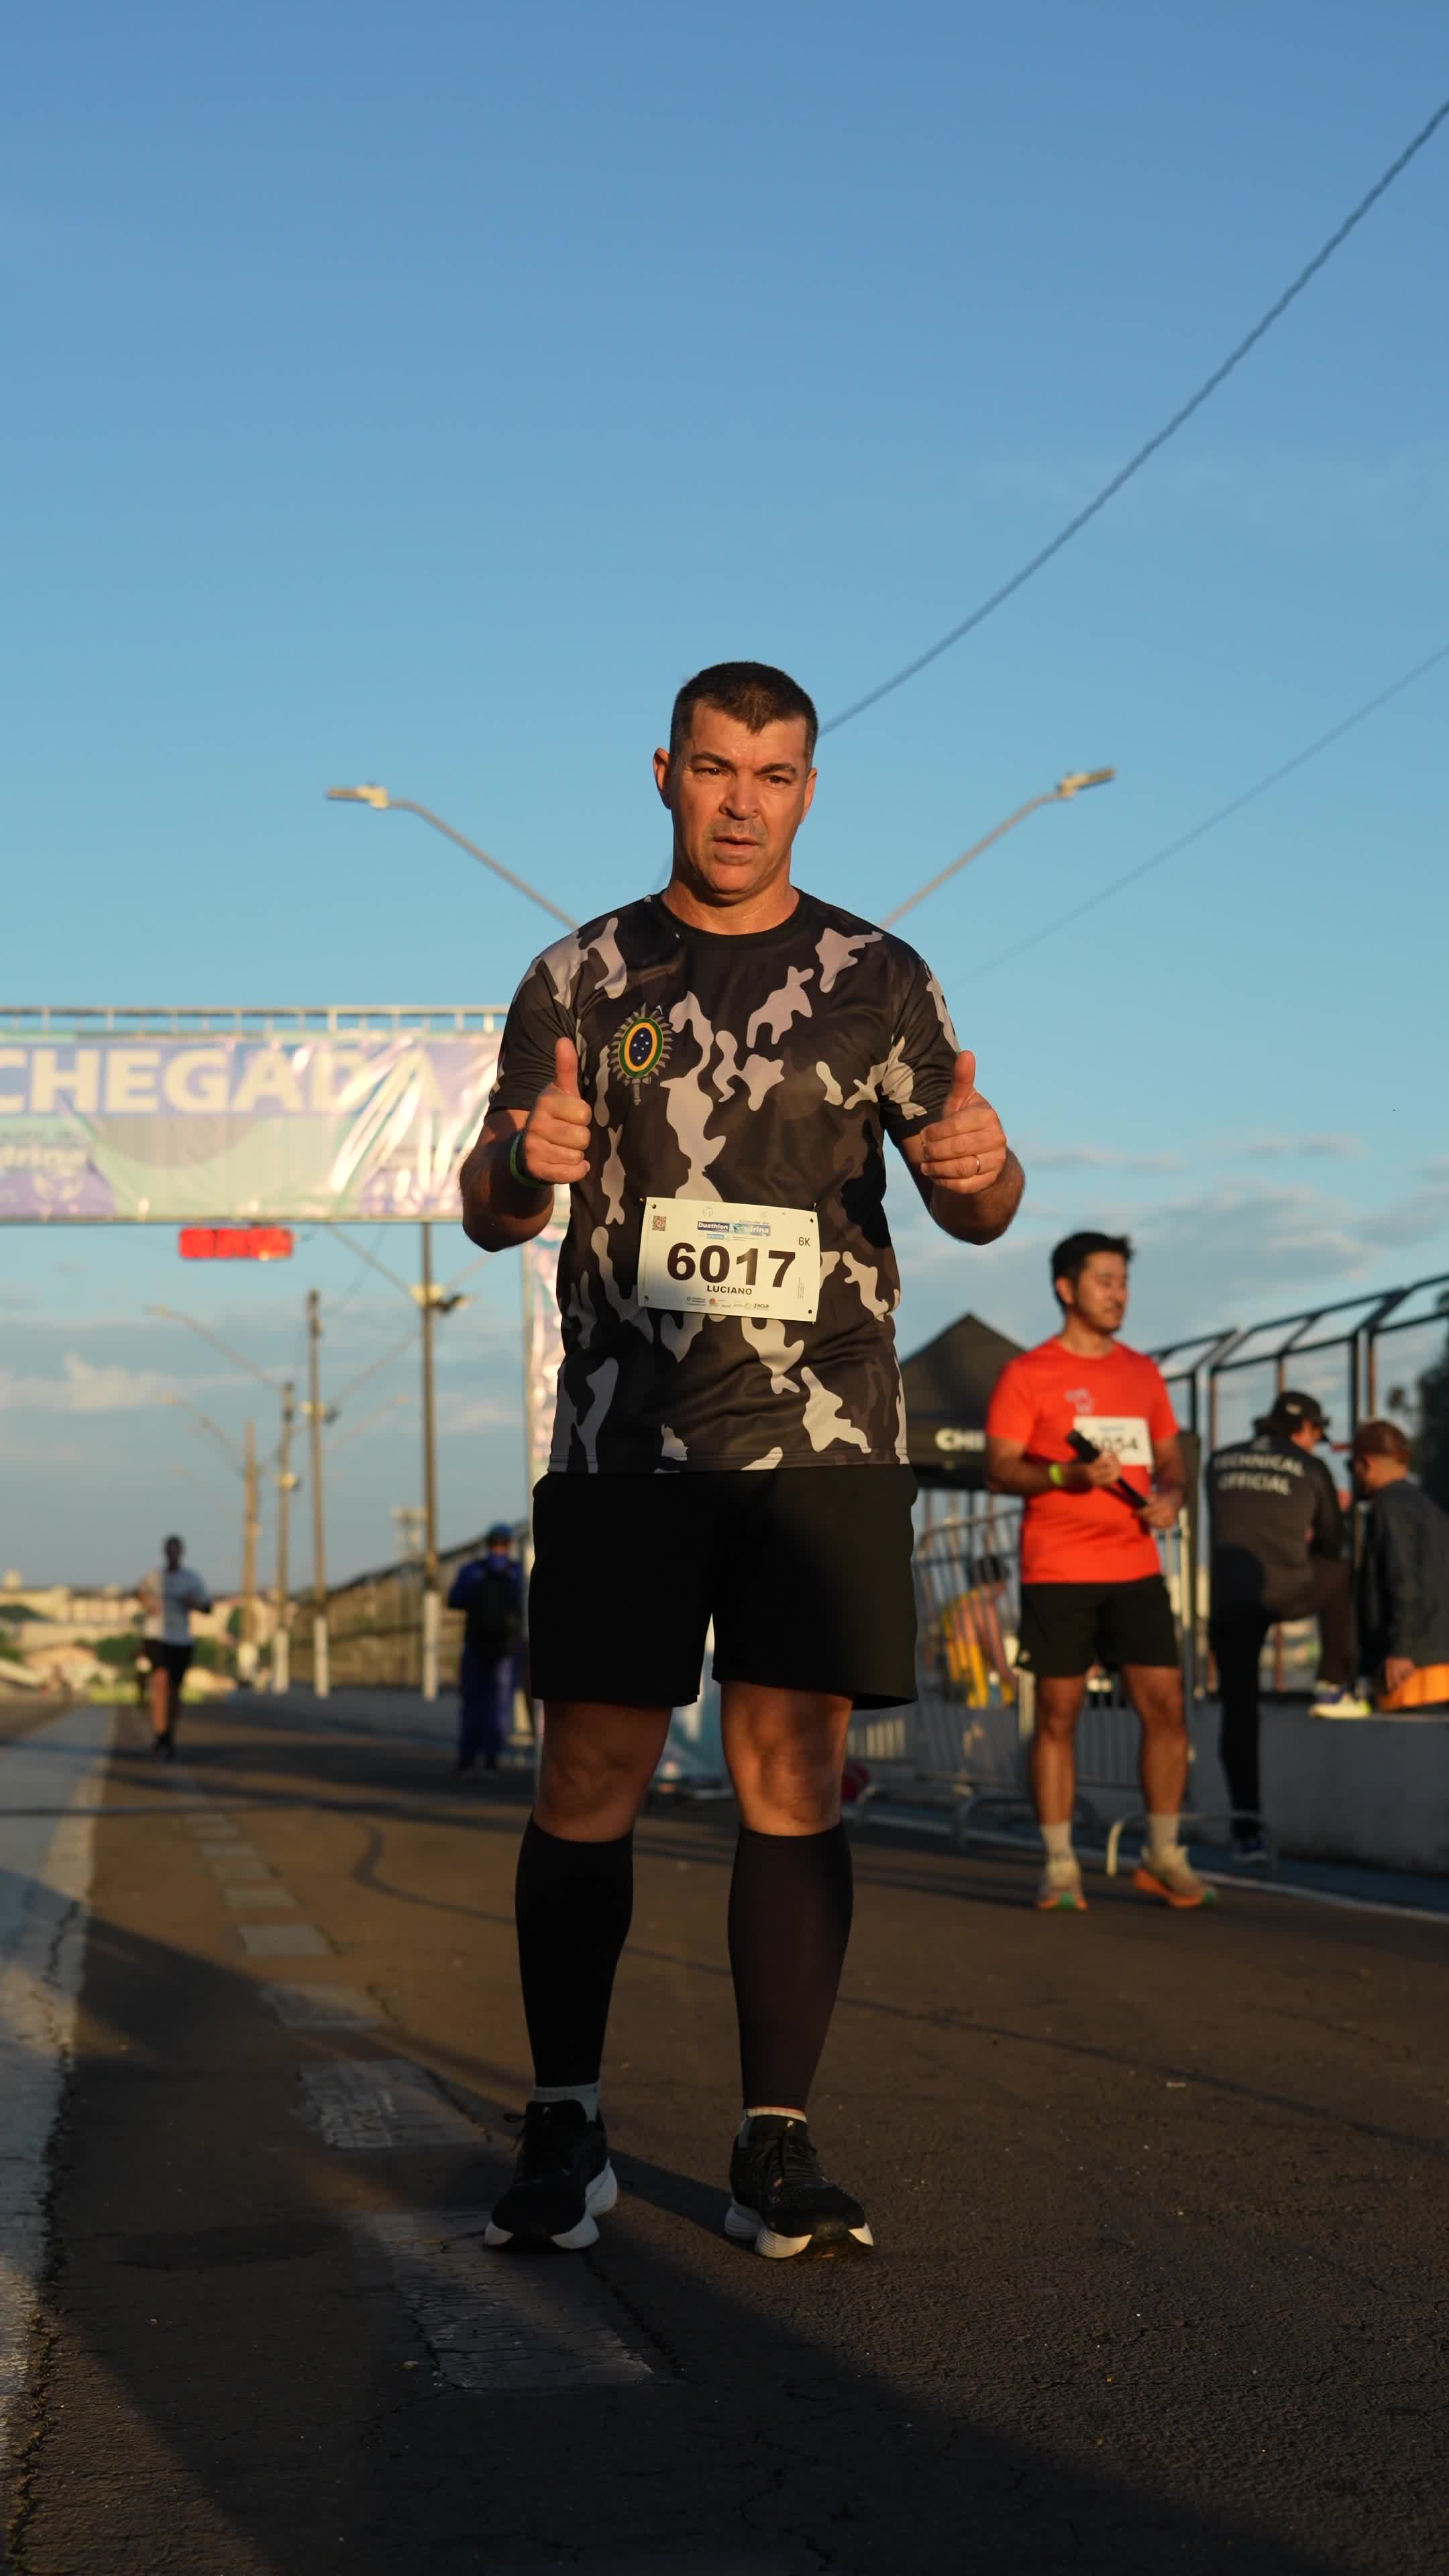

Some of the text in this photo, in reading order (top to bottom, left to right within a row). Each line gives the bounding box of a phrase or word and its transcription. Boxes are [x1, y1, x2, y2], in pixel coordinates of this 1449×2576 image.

[698, 1222, 729, 1230] Duathlon
[798, 1237, 810, 1246] 6K
[667, 1242, 796, 1287] 6017
[707, 1285, 752, 1295] LUCIANO
[1091, 1436, 1138, 1453] 054
[1218, 1472, 1292, 1495] OFFICIAL
